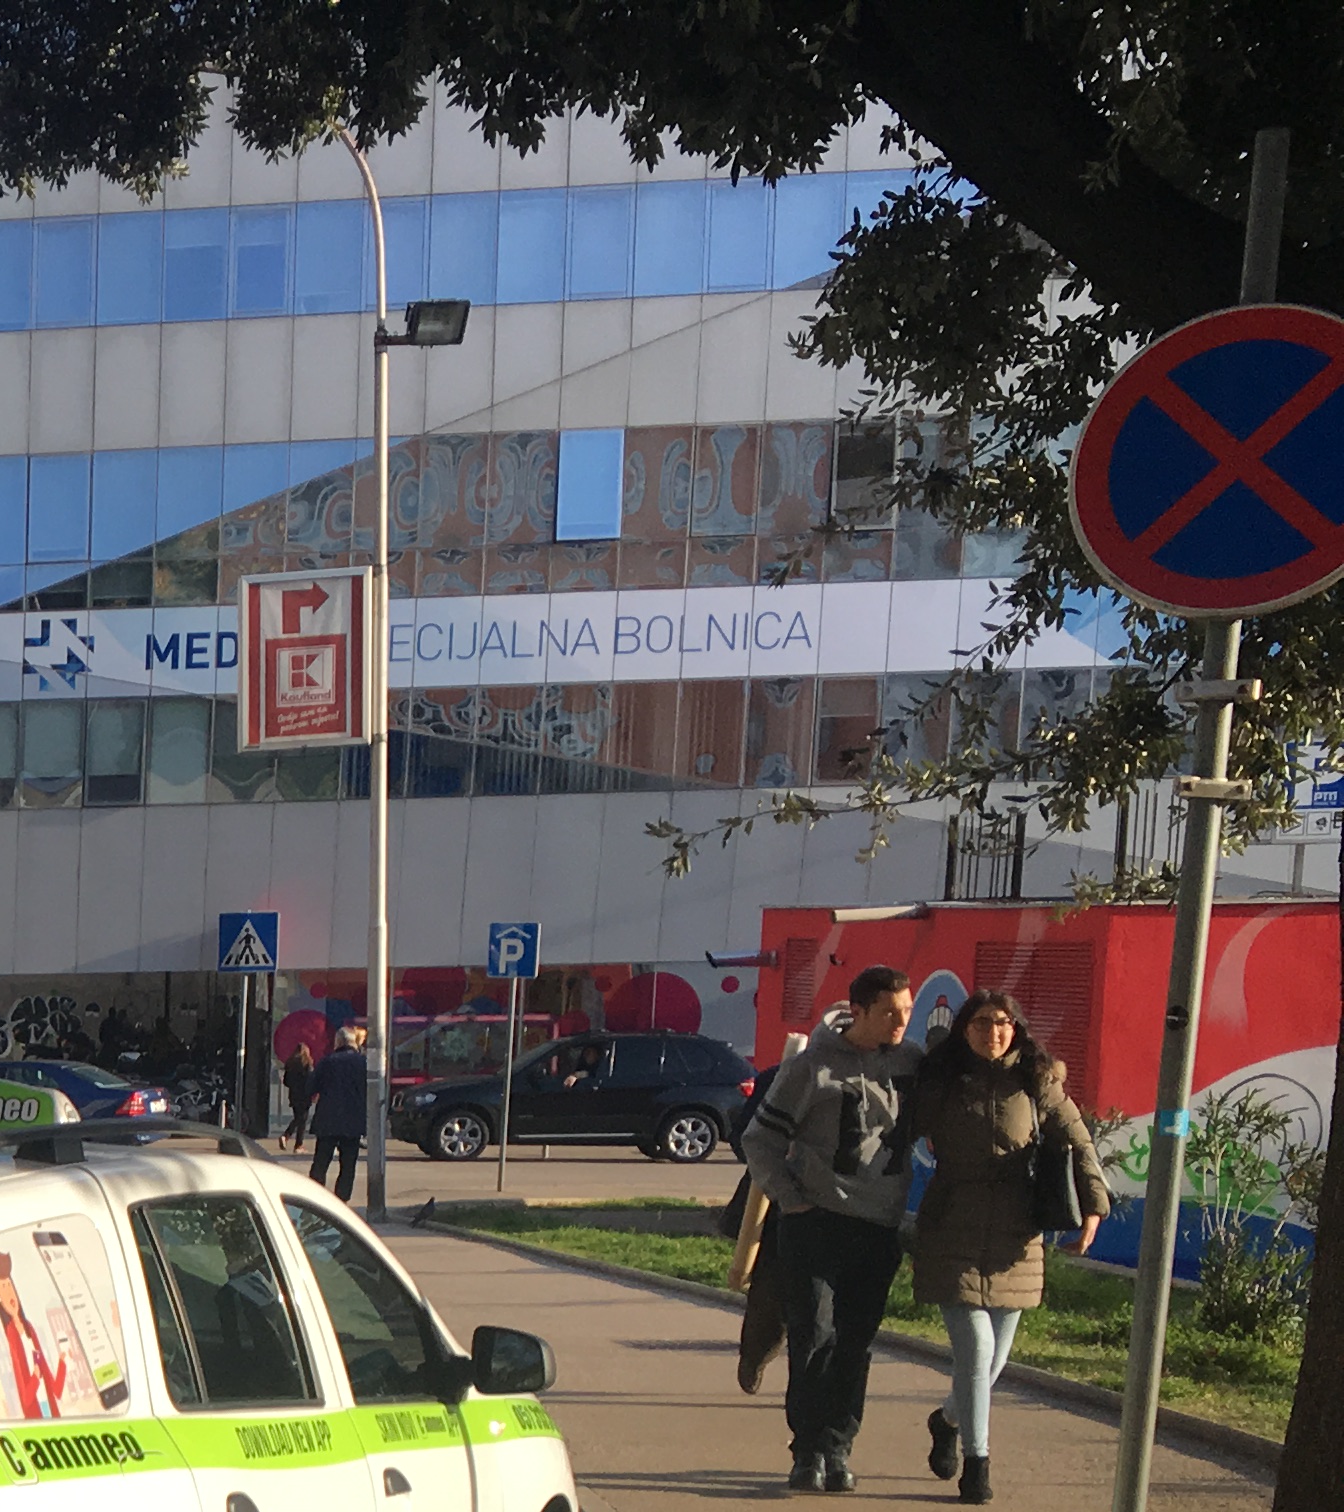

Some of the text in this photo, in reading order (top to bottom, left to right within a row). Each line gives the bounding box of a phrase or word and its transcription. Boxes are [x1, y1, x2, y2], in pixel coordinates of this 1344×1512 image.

[613, 611, 812, 655] BOLNICA
[280, 689, 332, 701] Kaufland
[499, 939, 525, 973] P
[235, 1420, 333, 1459] DOWNLOAD NEW APP
